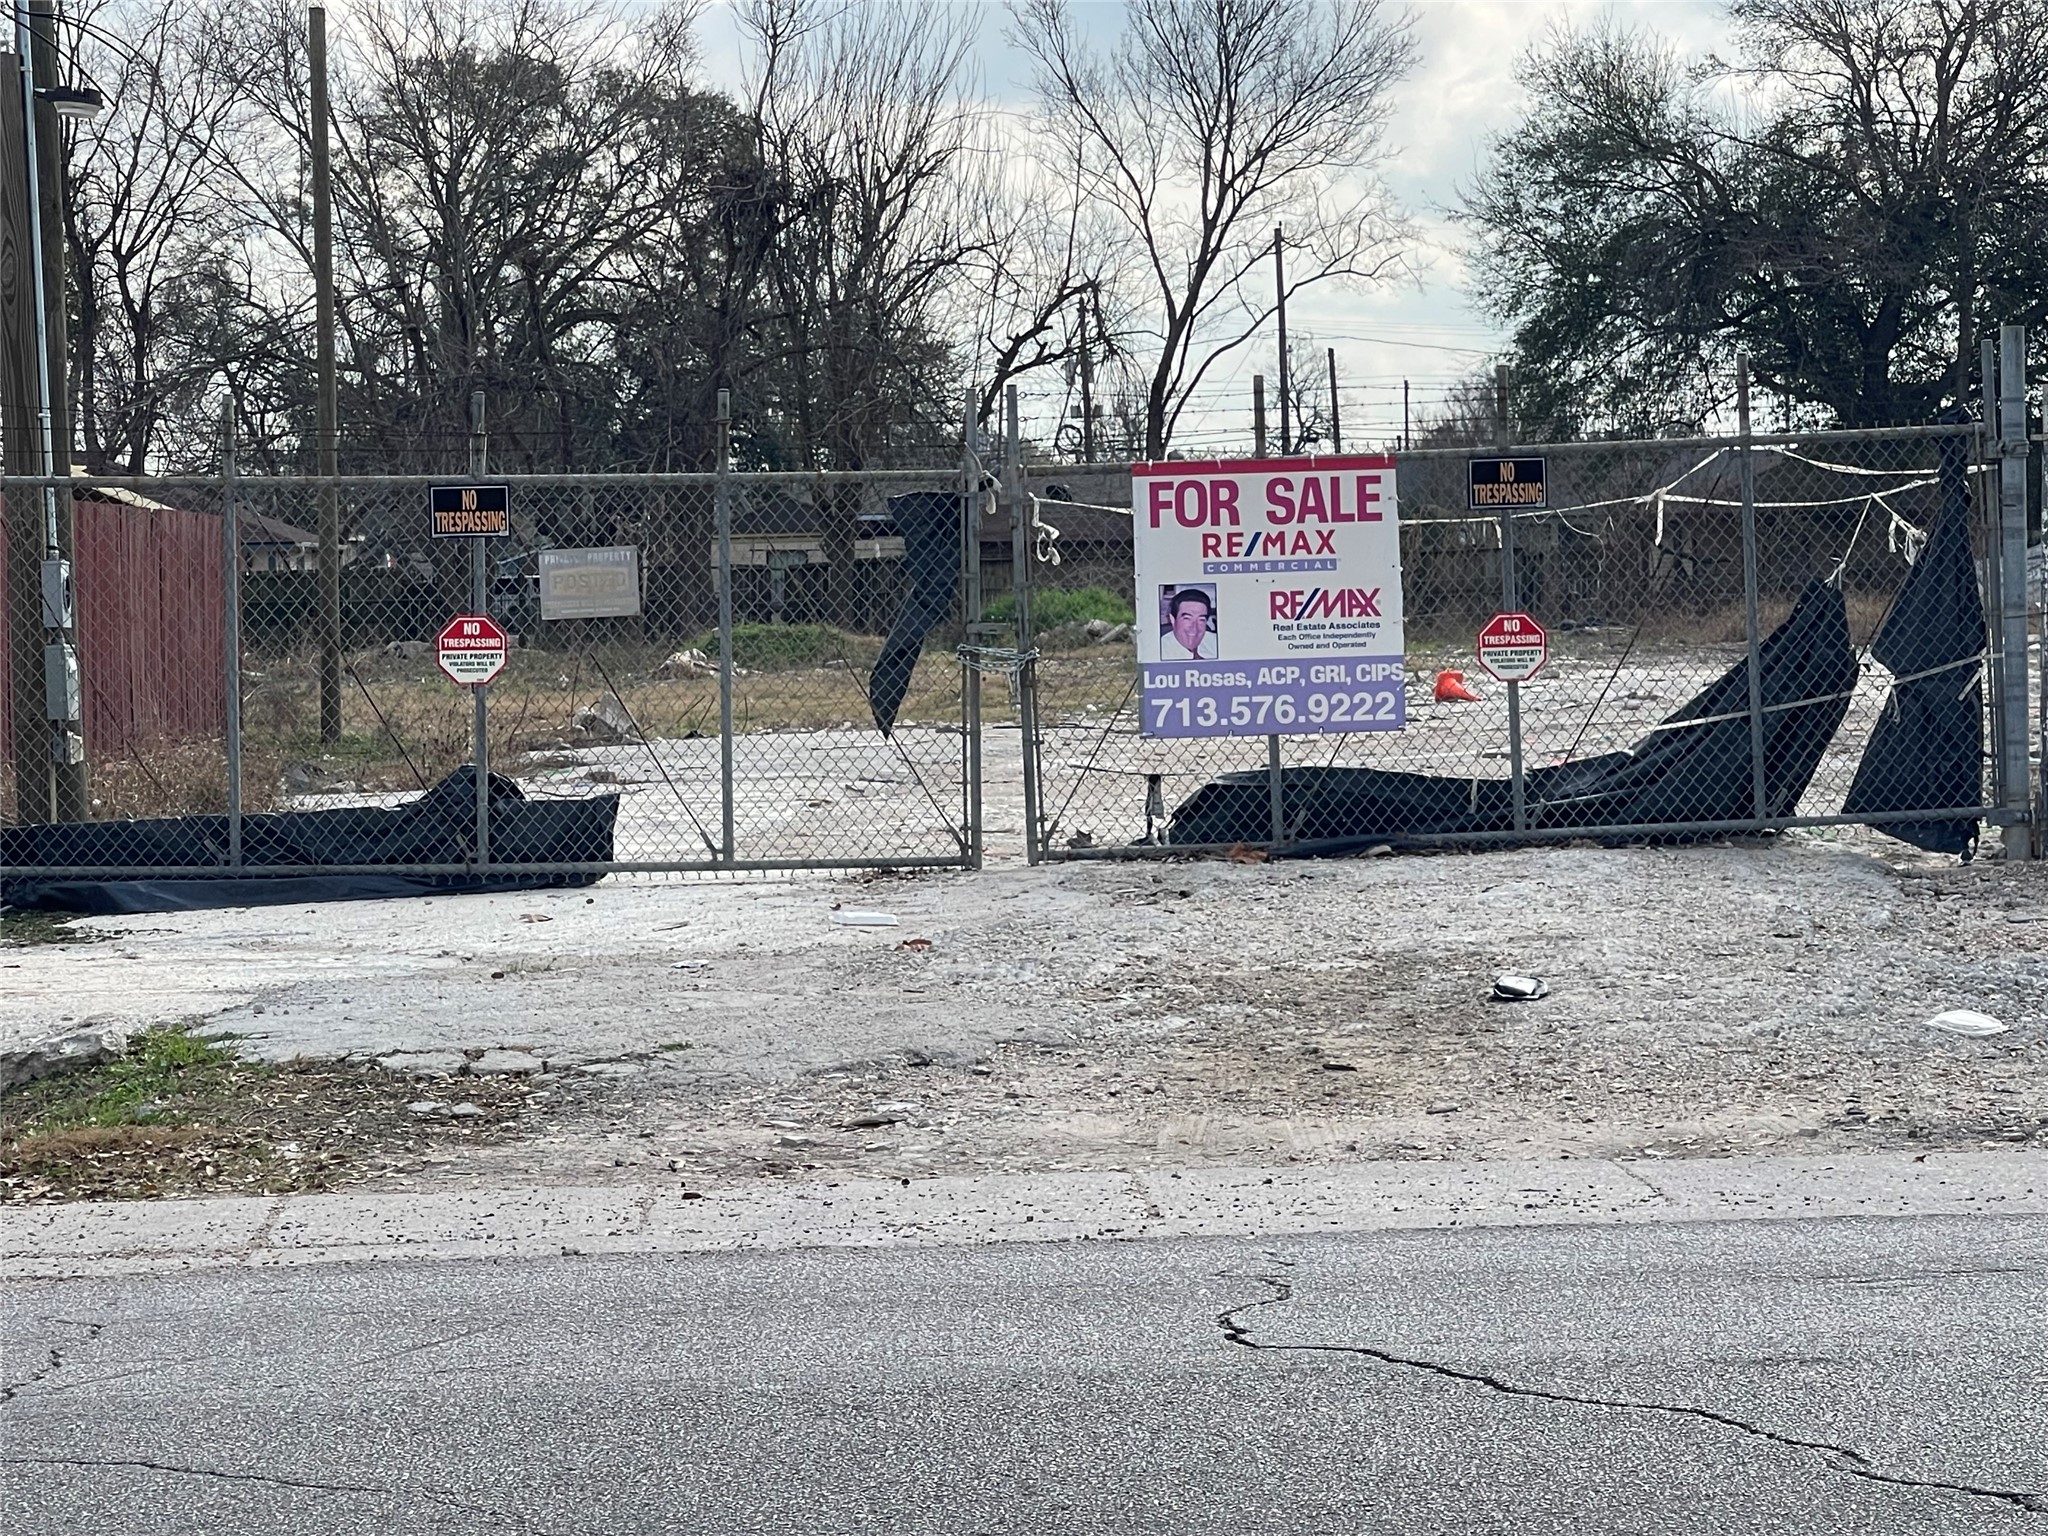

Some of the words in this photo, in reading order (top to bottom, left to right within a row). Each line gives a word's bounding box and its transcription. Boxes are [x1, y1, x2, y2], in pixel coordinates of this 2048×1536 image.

[1500, 462, 1514, 482] NO
[1473, 482, 1543, 504] TRESPASSING
[462, 490, 477, 510] NO
[1149, 479, 1240, 528] FOR
[1266, 475, 1383, 525] SALE
[435, 511, 506, 532] TRESPASSING
[1202, 529, 1336, 558] RE/MAX
[1207, 560, 1334, 573] COMMERCIAL
[1270, 587, 1382, 621] RE/MAX
[463, 622, 480, 635] NO
[1273, 623, 1294, 631] Real
[1297, 622, 1327, 631] Estate
[1328, 621, 1381, 630] Associates
[1503, 619, 1520, 632] NO
[1322, 631, 1376, 640] Independently
[1483, 634, 1541, 645] TRESPASSING
[443, 638, 501, 648] TRESPASSING
[1332, 641, 1367, 649] Operated
[470, 652, 503, 660] PROPERTY
[1510, 649, 1542, 657] PROPERTY
[1143, 671, 1179, 688] Lou
[1185, 669, 1252, 688] Rosas,
[1257, 666, 1305, 687] ACP,
[1310, 664, 1351, 685] GRI,
[1356, 663, 1405, 682] CIPS
[1151, 691, 1396, 728] 713.576.9222
